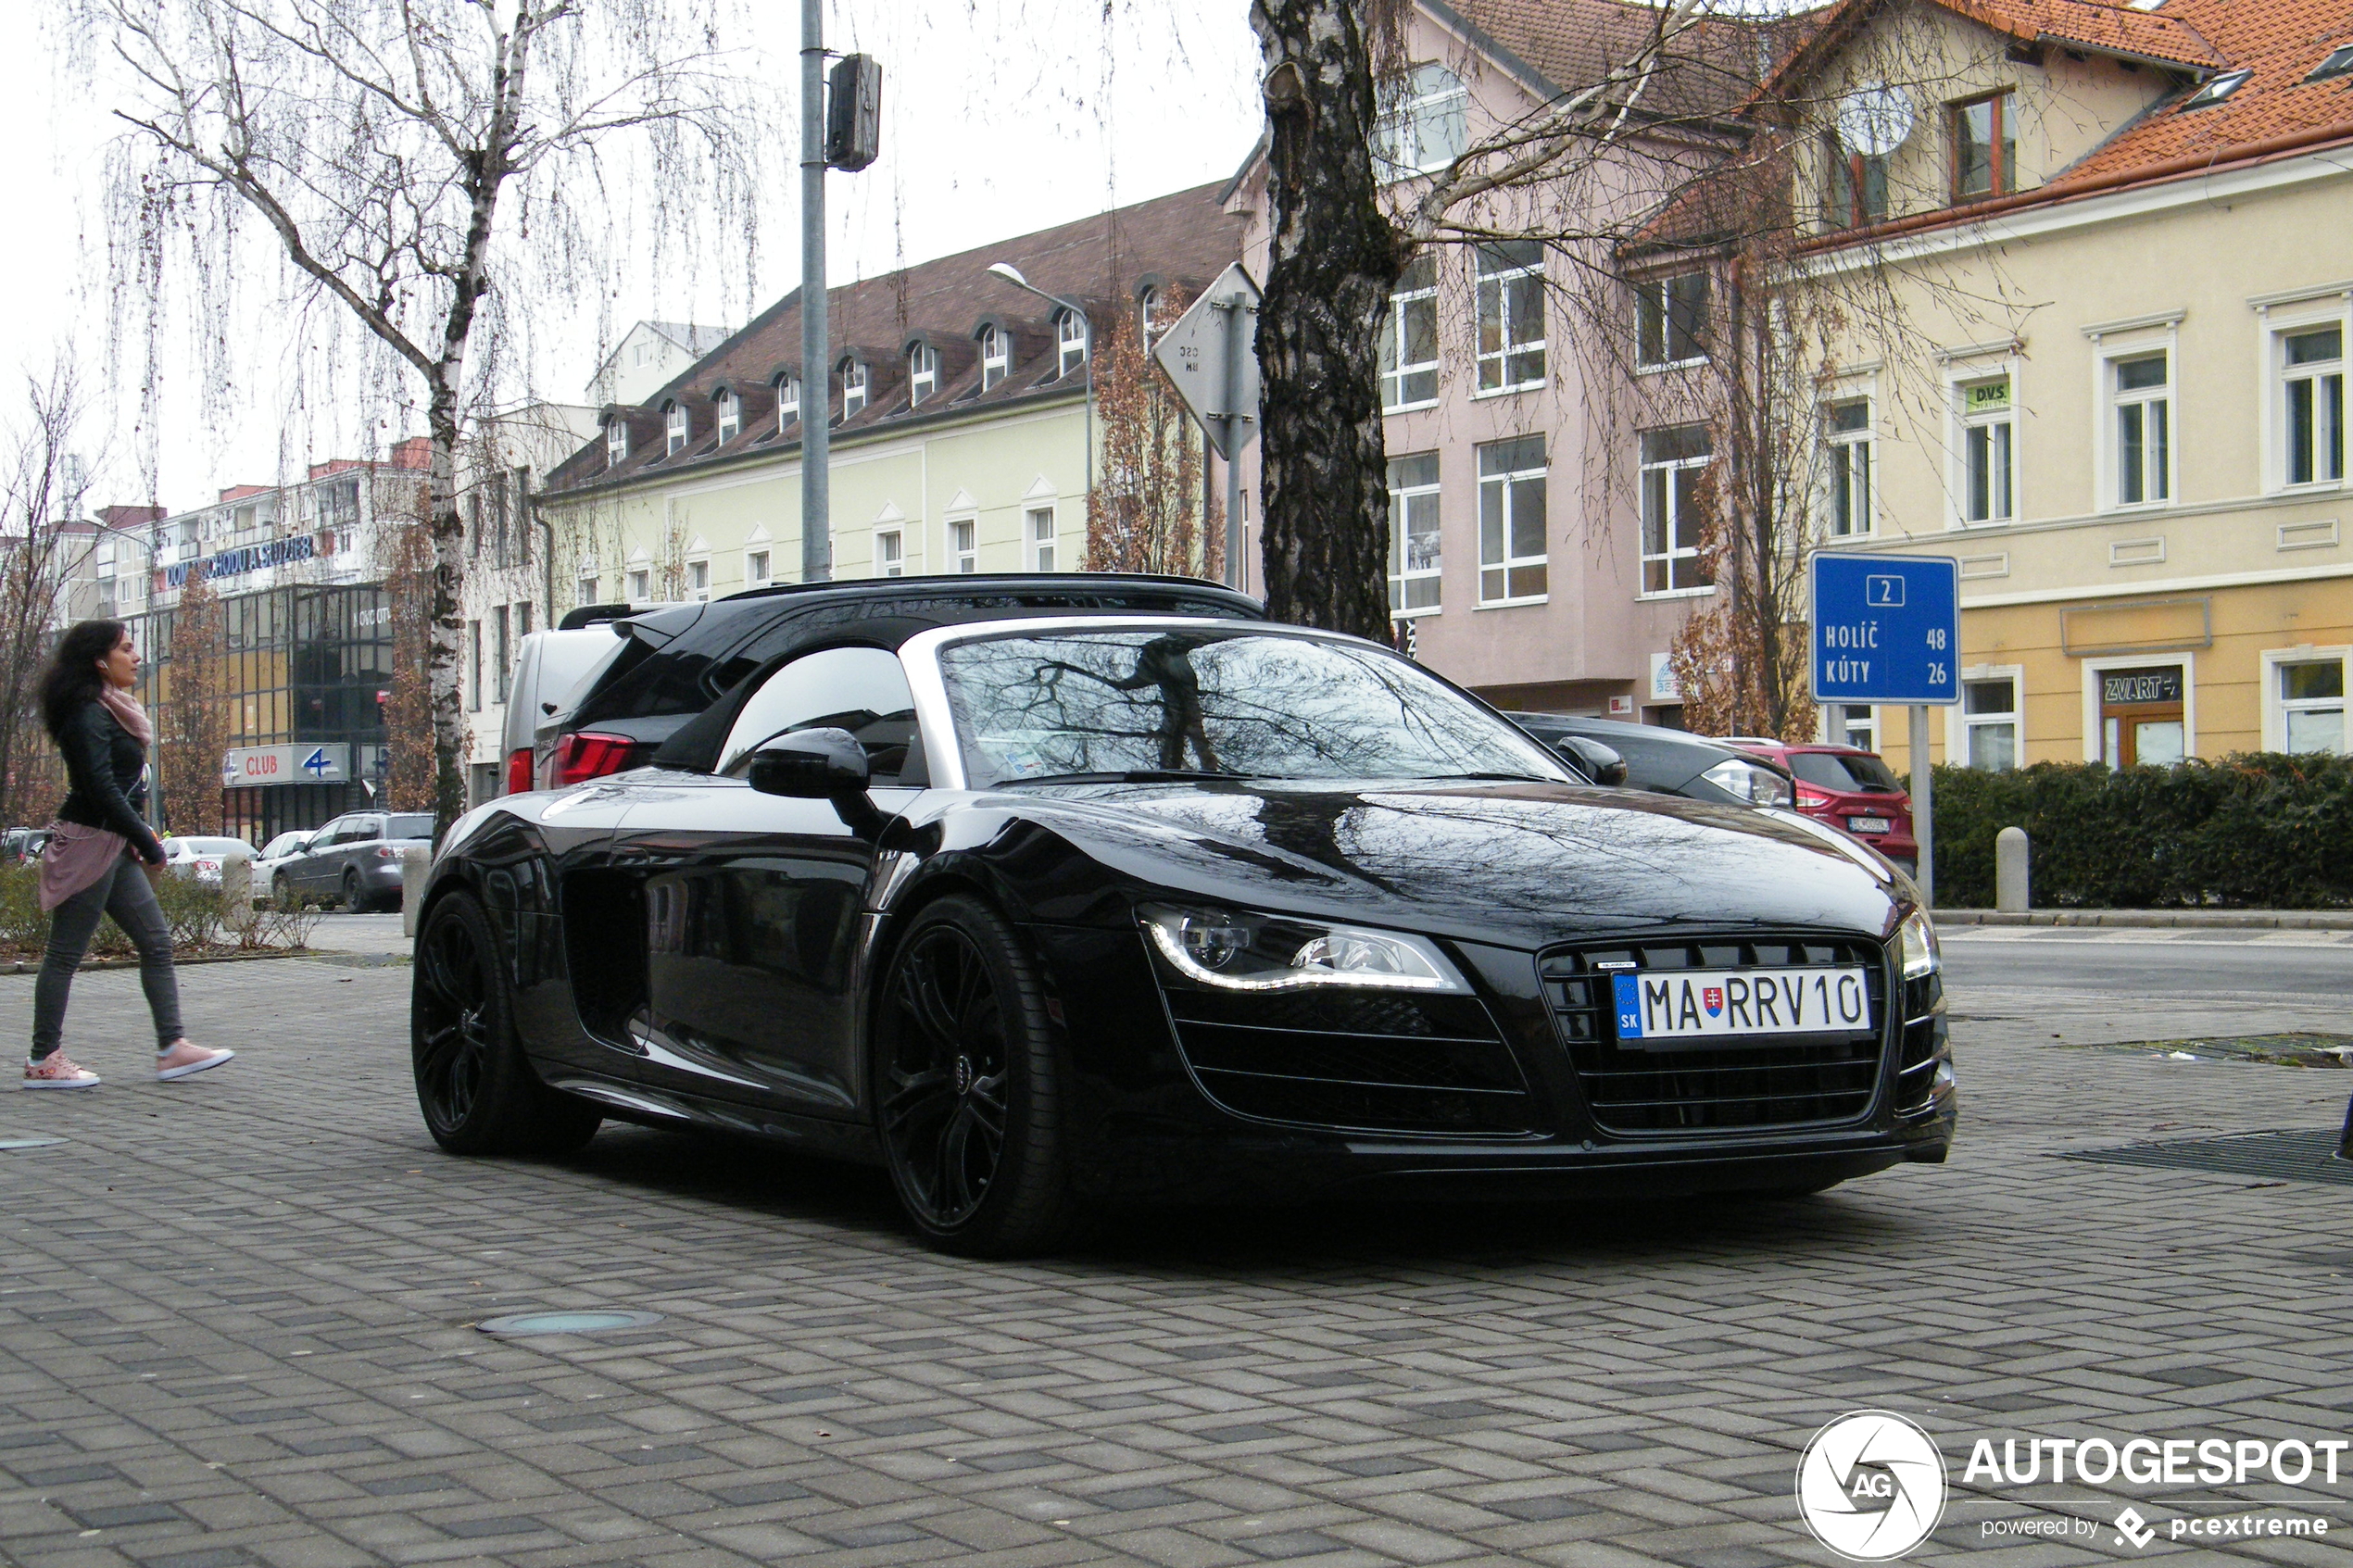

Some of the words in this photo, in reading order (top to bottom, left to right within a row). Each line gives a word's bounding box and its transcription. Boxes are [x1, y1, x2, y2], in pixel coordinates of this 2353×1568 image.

[249, 548, 258, 570] A
[1881, 579, 1891, 602] 2
[1825, 621, 1879, 648] HOLÍČ
[1926, 628, 1946, 651] 48
[1826, 655, 1870, 684] KÚTY
[1927, 662, 1947, 684] 26
[245, 755, 277, 776] CLUB
[1645, 978, 1702, 1031] MA
[1726, 974, 1863, 1028] RRV10
[1621, 1013, 1638, 1028] SK
